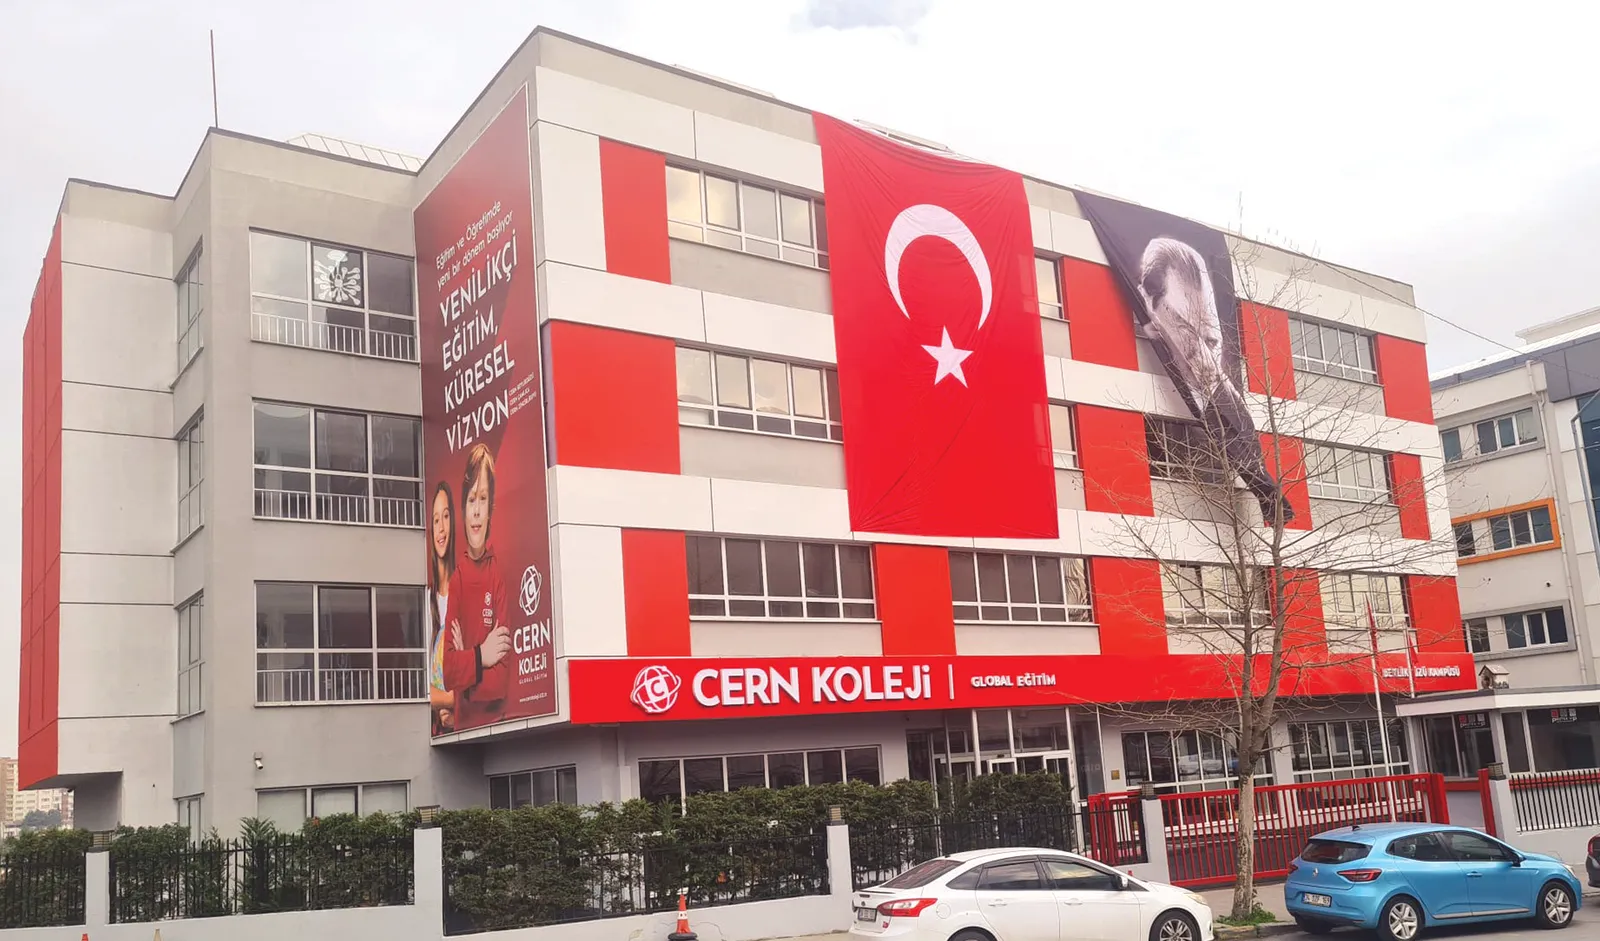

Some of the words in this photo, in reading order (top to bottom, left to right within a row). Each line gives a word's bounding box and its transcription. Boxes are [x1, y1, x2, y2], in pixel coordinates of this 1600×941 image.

[436, 246, 455, 270] Eğitim
[456, 237, 465, 250] ve
[466, 201, 501, 241] Öğretimde
[438, 267, 451, 292] yeni
[452, 259, 461, 276] bir
[462, 239, 485, 266] dönem
[487, 210, 513, 244] başlıyor
[440, 229, 517, 327] YENİLİKÇİ
[443, 305, 498, 371] EĞİTİM,
[444, 340, 515, 414] KÜRESEL
[446, 389, 509, 454] VİZYON
[513, 618, 551, 654] CERN
[692, 666, 800, 707] CERN
[970, 674, 1014, 688] GLOBAL
[1016, 672, 1056, 687] EĞİTİM
